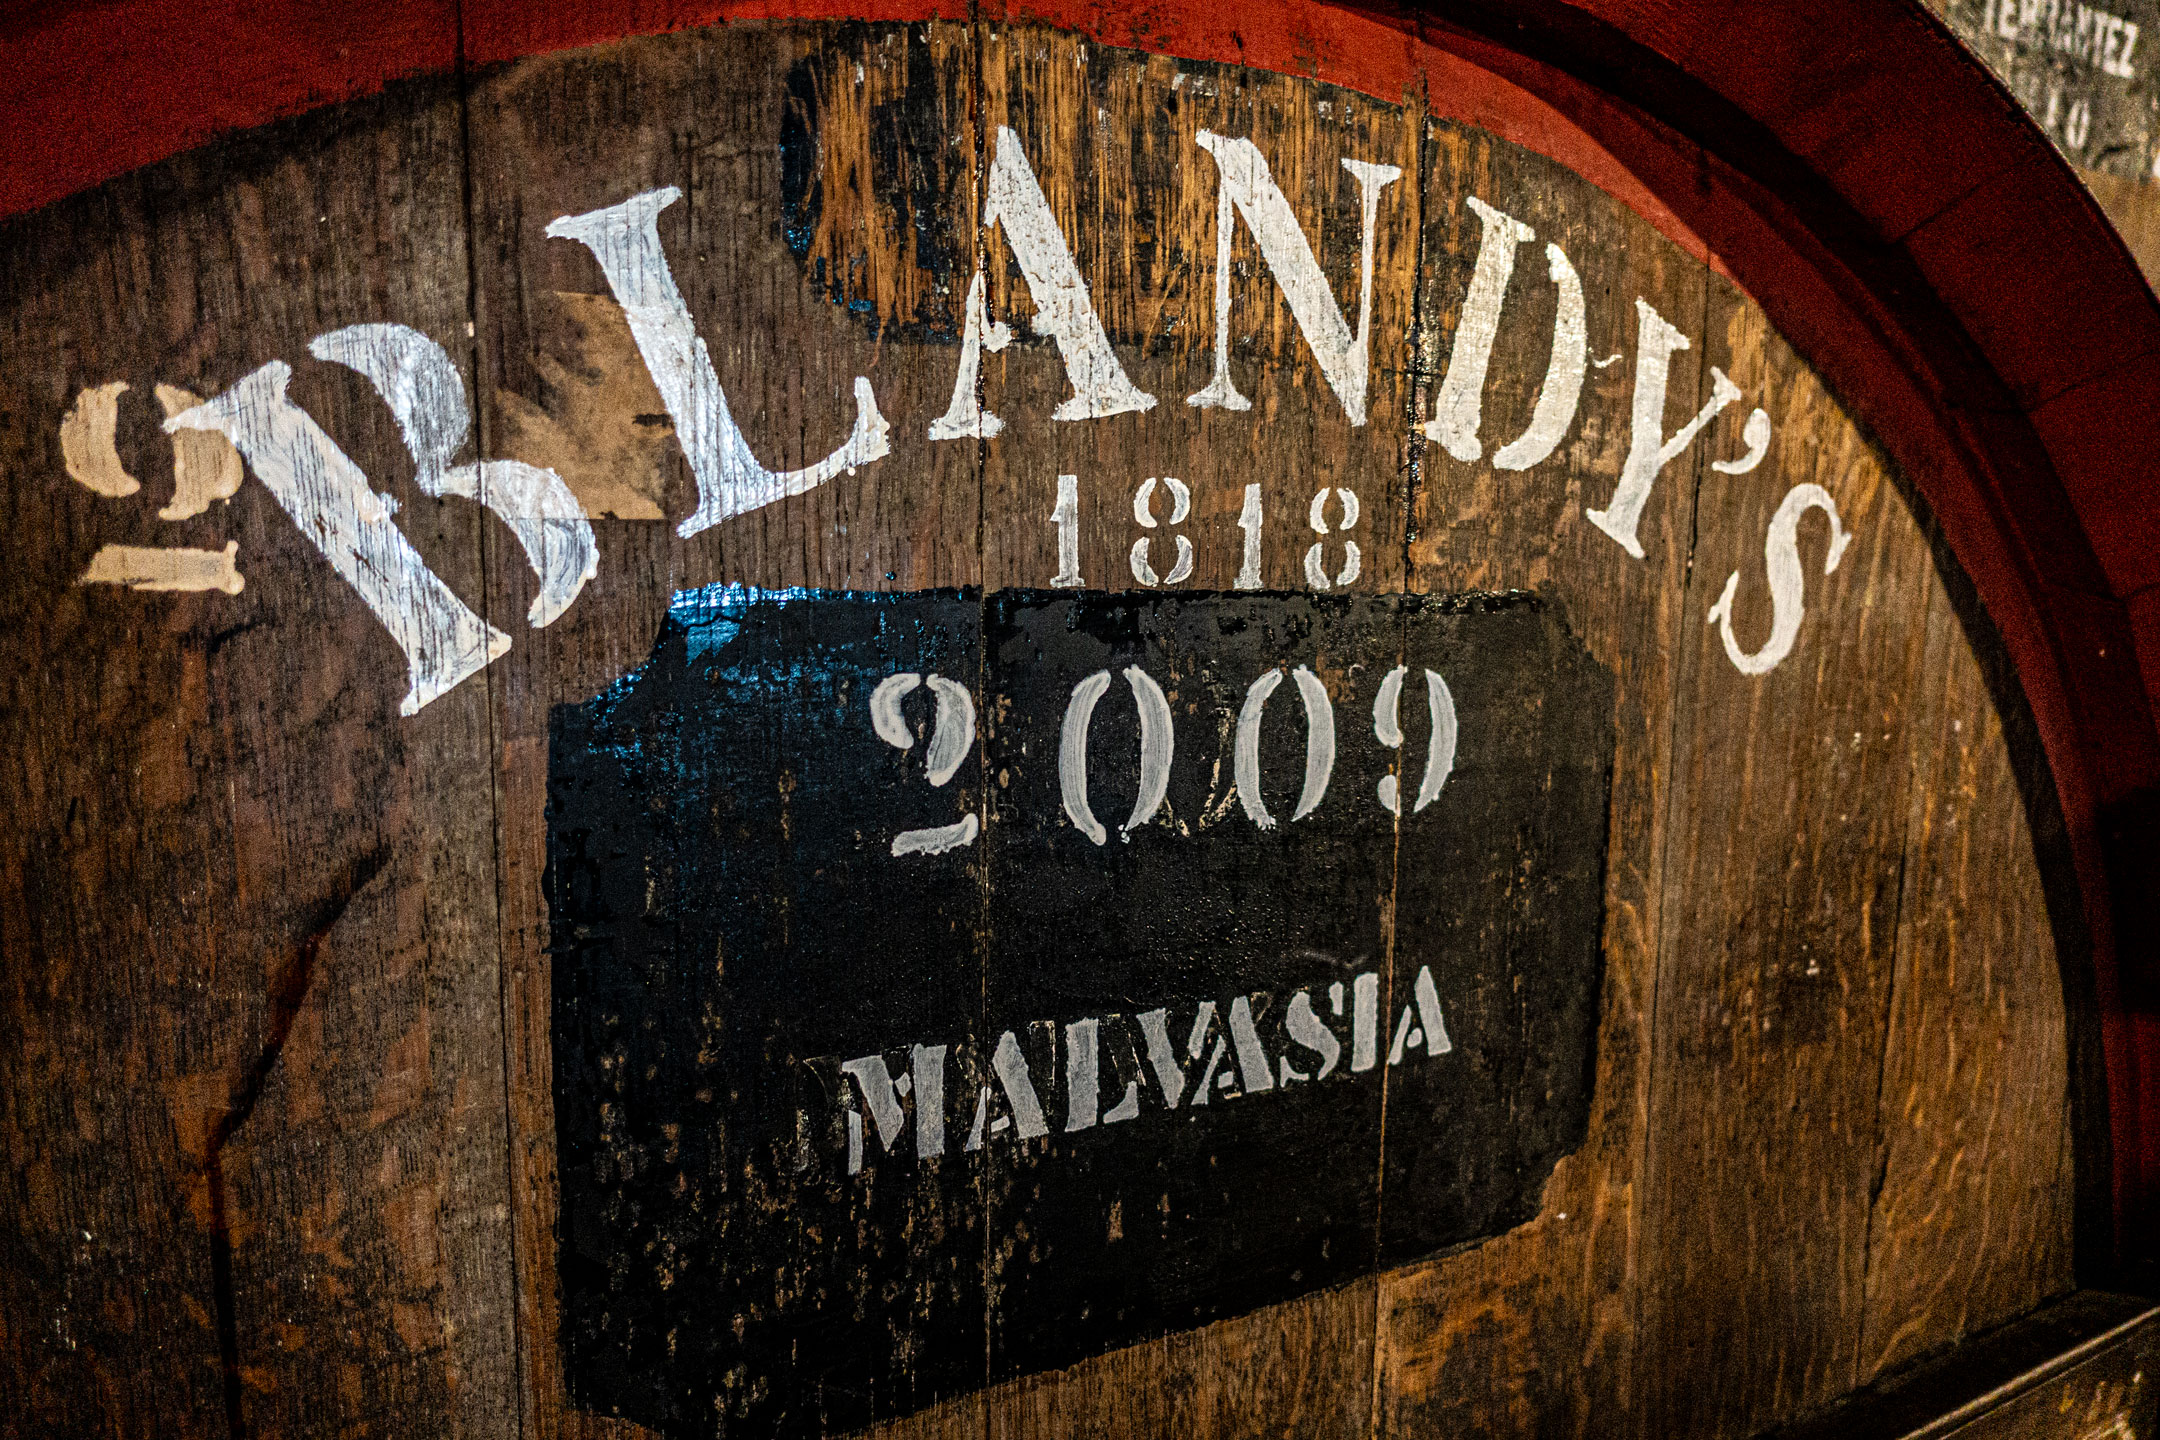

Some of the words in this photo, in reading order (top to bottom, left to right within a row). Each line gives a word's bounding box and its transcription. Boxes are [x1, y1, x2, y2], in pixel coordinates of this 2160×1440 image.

[1049, 474, 1362, 590] 1818
[870, 664, 1457, 856] 2009
[841, 964, 1453, 1176] MALVASIA
